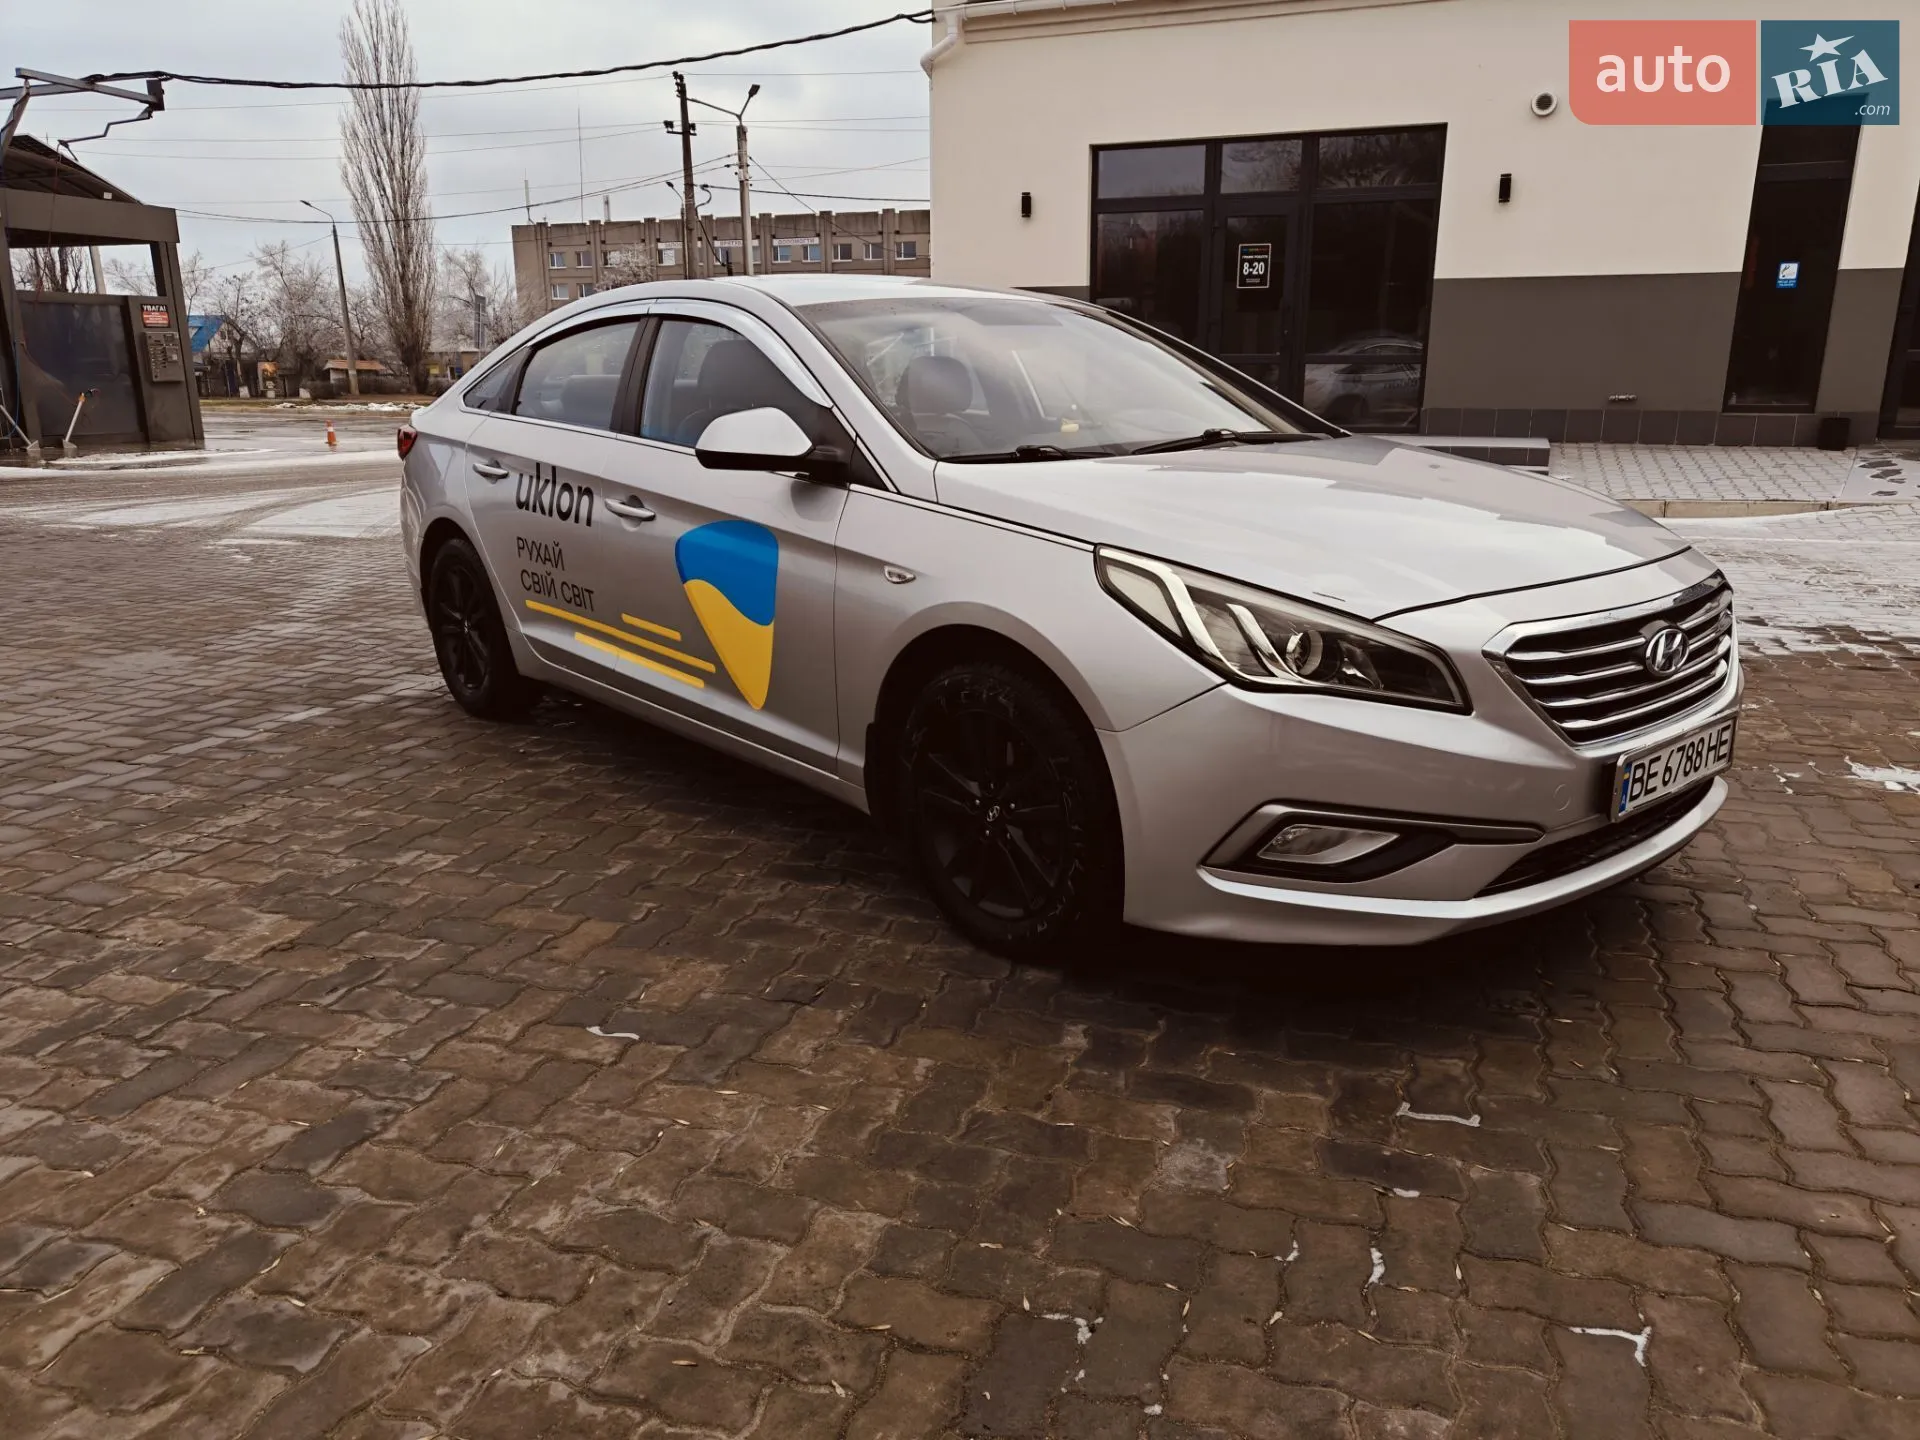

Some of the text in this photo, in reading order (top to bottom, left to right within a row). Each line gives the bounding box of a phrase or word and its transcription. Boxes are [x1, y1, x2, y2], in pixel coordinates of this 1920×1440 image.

[1242, 261, 1265, 275] 8-20
[515, 461, 595, 527] uklon
[516, 535, 565, 571] РУХАЙ
[520, 568, 595, 612] СВІЙ СВІТ
[1661, 736, 1705, 787] 6788
